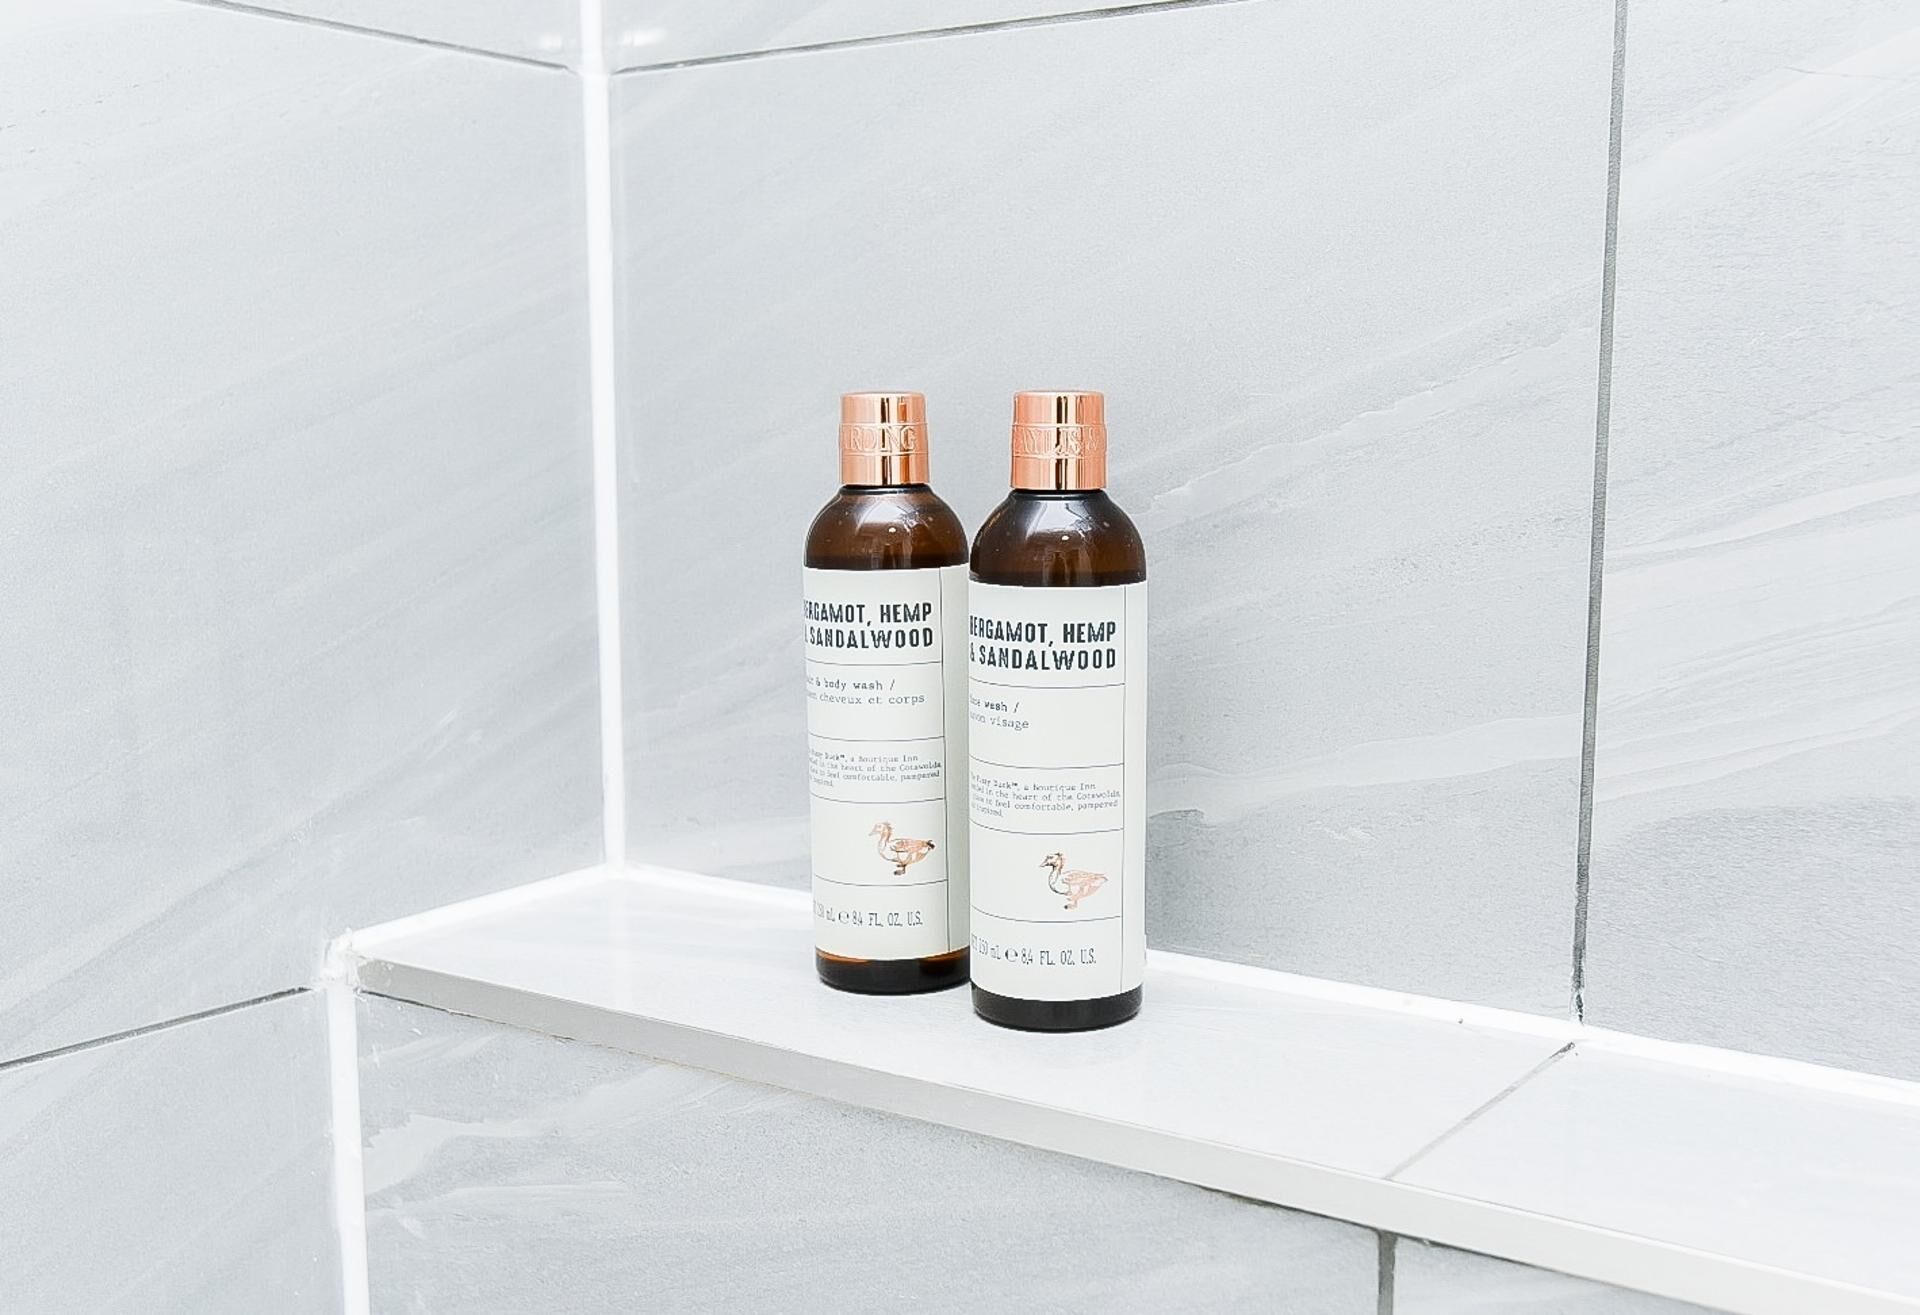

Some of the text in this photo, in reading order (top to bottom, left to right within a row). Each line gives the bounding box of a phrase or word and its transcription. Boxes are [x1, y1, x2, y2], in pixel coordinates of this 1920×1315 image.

[880, 602, 932, 623] HEMP
[810, 626, 933, 649] SANDALWOOD
[1063, 621, 1116, 643] HEMP
[979, 644, 1116, 670] SANDALWOOD
[824, 677, 847, 692] body
[853, 680, 883, 690] wash
[819, 692, 862, 705] cheveux
[868, 696, 883, 705] et
[889, 694, 925, 706] corps
[984, 701, 1008, 713] wash
[989, 717, 1030, 731] visage
[903, 754, 918, 762] Inn
[840, 763, 864, 772] heart
[866, 764, 876, 772] of
[880, 764, 896, 772] the
[900, 770, 940, 782] pampered
[1079, 783, 1096, 791] Inn
[995, 789, 1009, 799] the
[1012, 792, 1037, 801] heart
[1042, 793, 1052, 801] of
[1057, 792, 1073, 801] the
[1014, 802, 1074, 812] comfortable,
[1077, 800, 1118, 811] pampered
[1040, 950, 1056, 966] FL.
[1060, 950, 1075, 966] OZ.
[1080, 948, 1097, 965] U.S.
